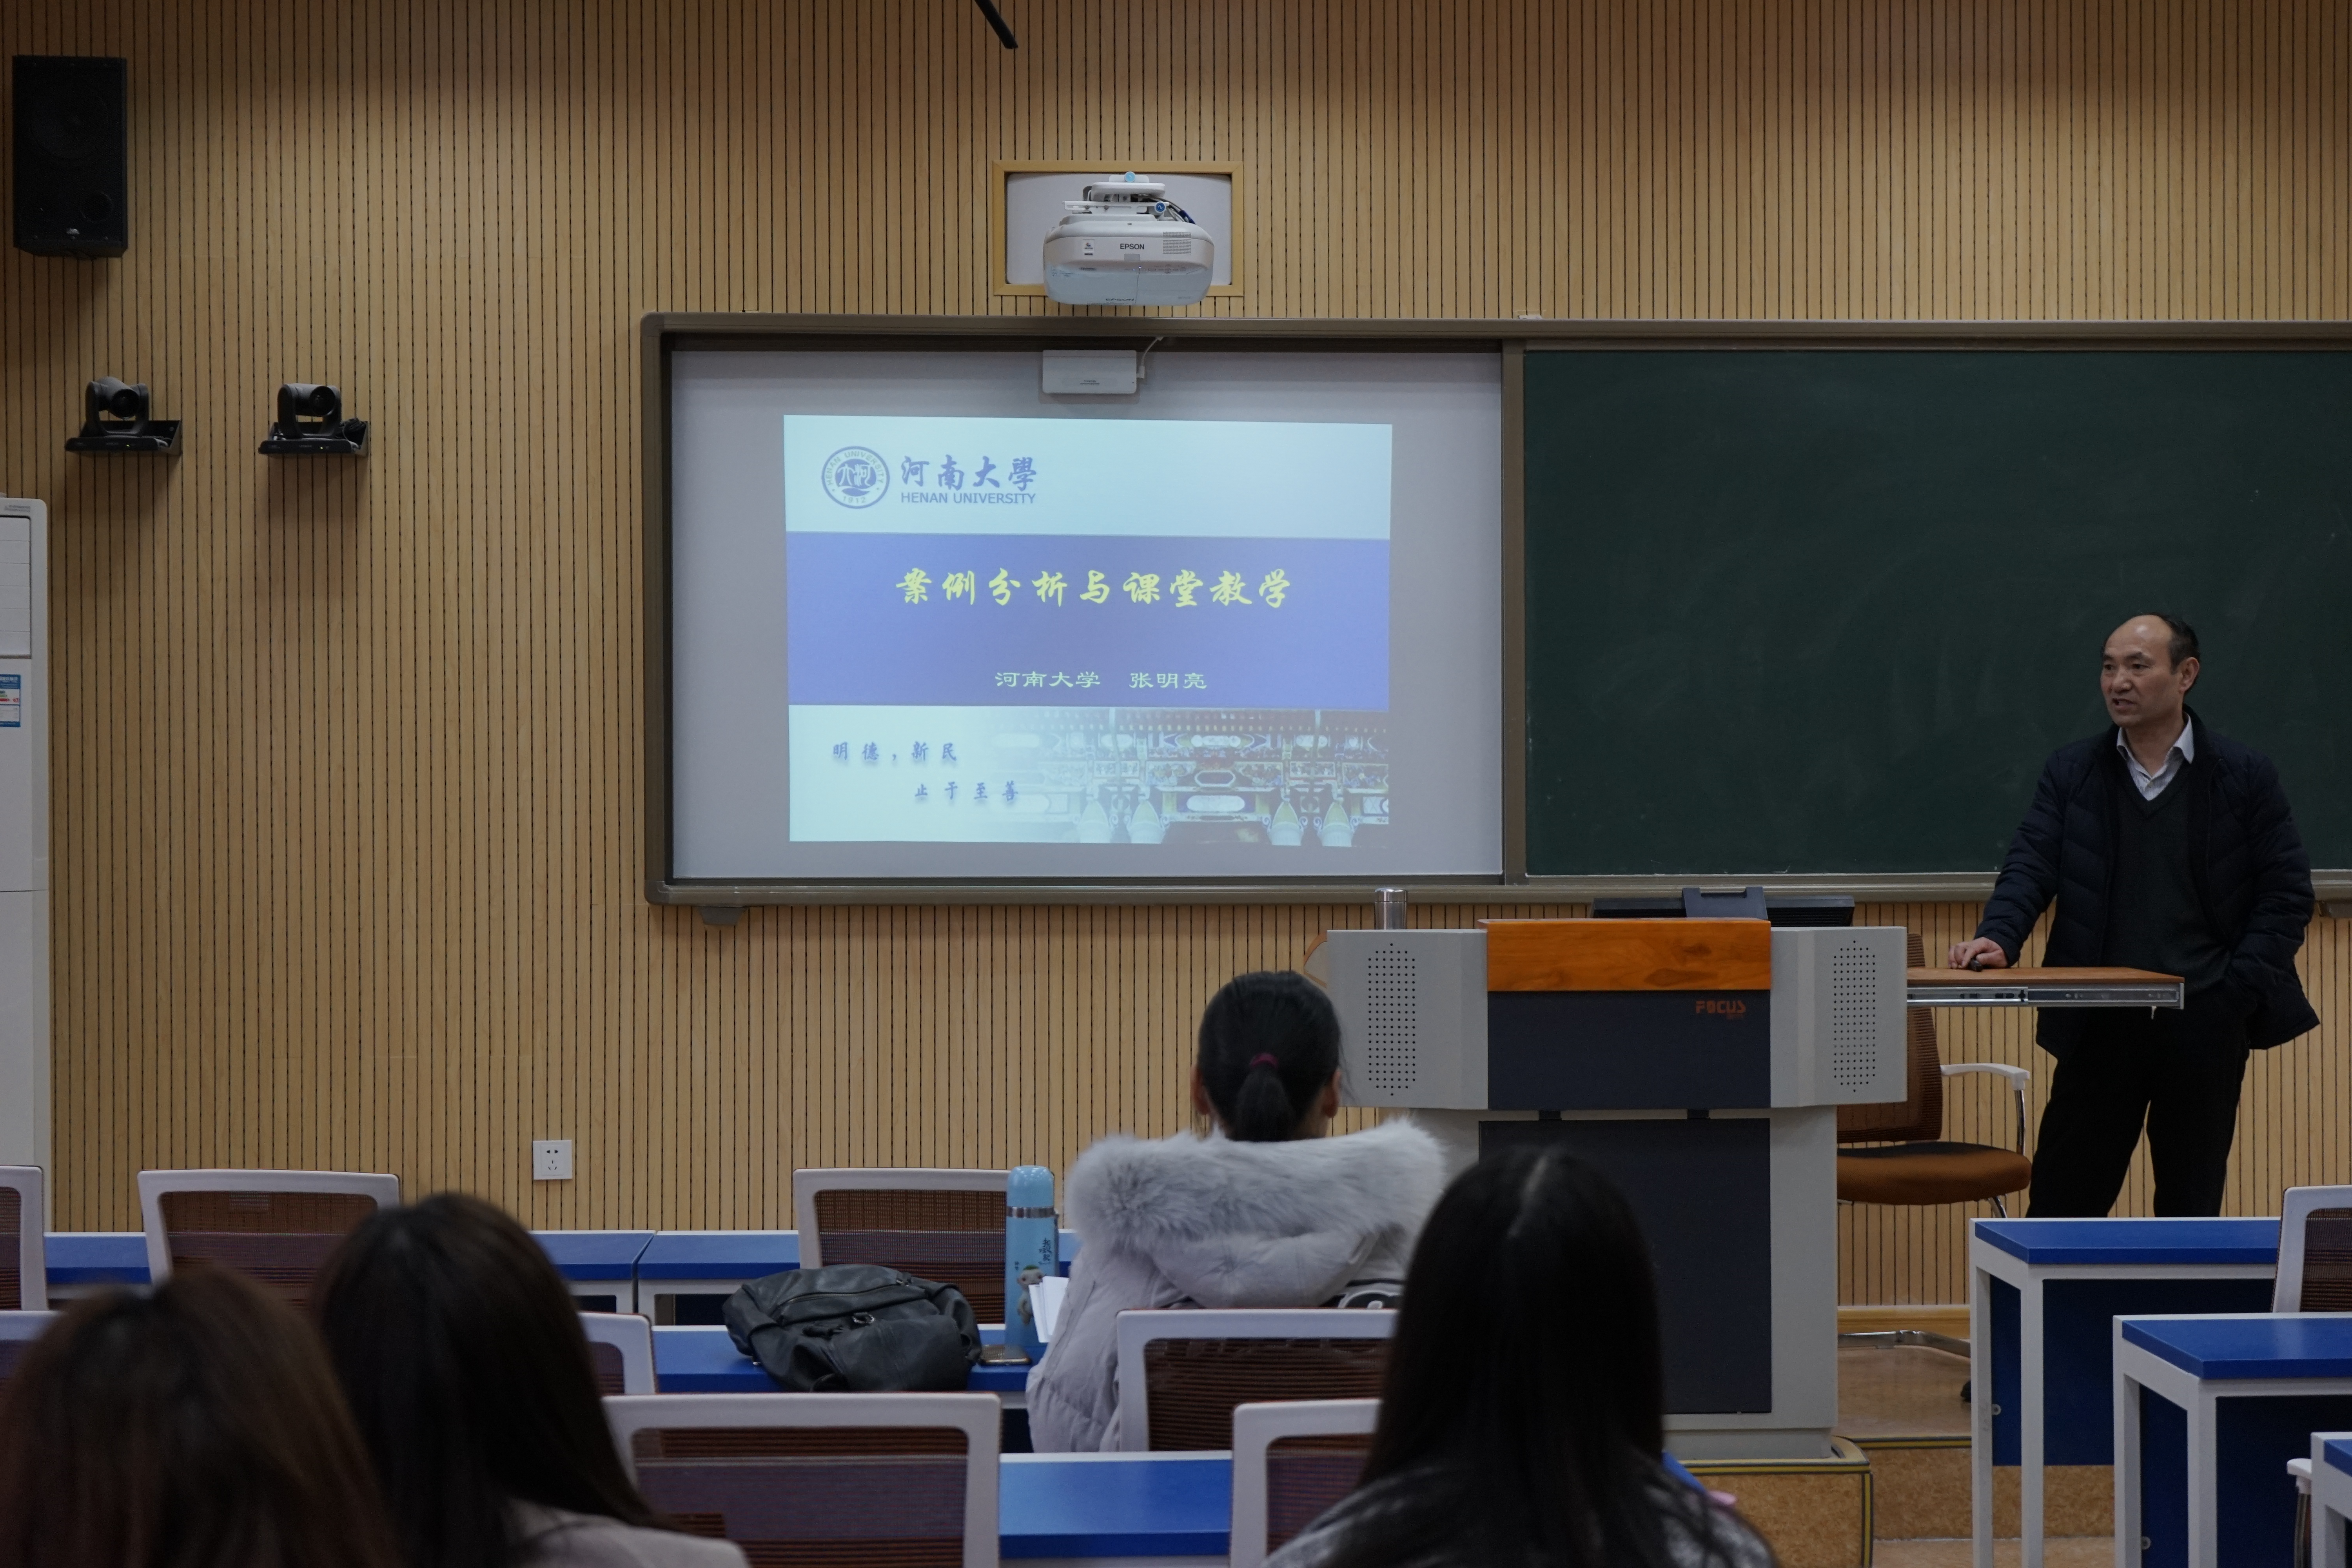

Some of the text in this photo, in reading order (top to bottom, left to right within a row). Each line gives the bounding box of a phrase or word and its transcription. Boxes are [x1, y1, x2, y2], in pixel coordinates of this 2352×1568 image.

[826, 450, 885, 486] HENAN UNIVERSITY
[901, 454, 1037, 492] 河南大學
[901, 492, 1036, 505] HENAN UNIVERSITY
[895, 568, 1290, 608] 案例分析与课堂教学
[995, 671, 1207, 690] 河南大学 张明亮
[915, 780, 1019, 802] 止于至善
[1695, 1000, 1746, 1014] FOCUS
